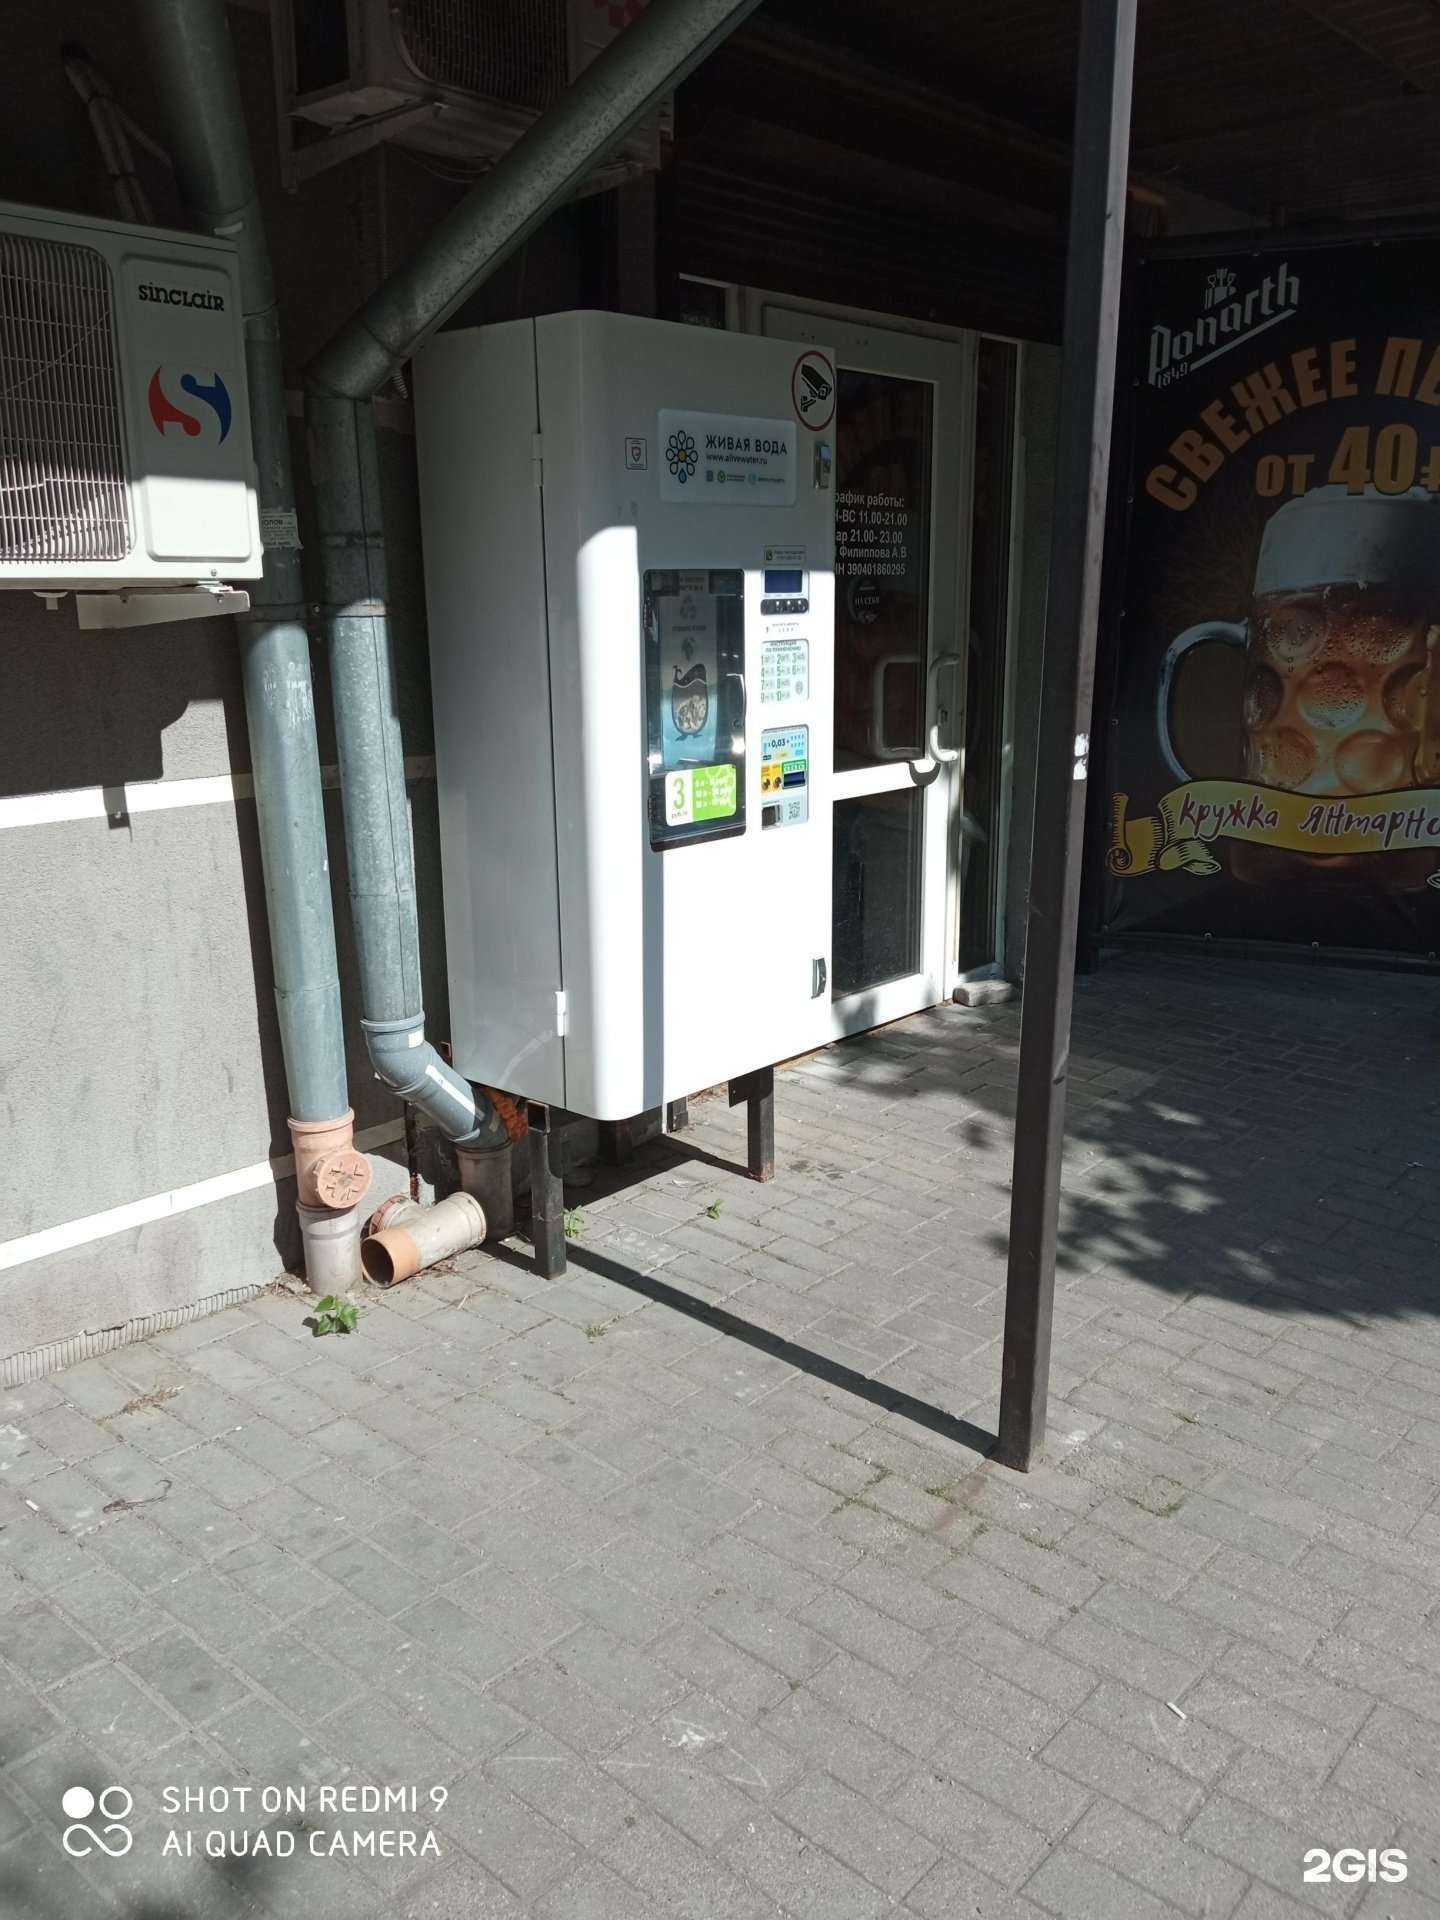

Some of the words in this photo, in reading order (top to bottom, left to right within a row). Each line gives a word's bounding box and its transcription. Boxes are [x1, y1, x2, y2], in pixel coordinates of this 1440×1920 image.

[1144, 337, 1360, 512] СВЕЖЕЕ
[705, 434, 751, 452] ЖИВАЯ
[755, 439, 788, 456] ВОДА
[1256, 453, 1316, 498] ОТ
[834, 489, 865, 508] рафик
[867, 492, 905, 509] работы:
[858, 509, 908, 526] 11.00-21.00
[835, 530, 848, 544] ар
[839, 544, 891, 559] Филиппова
[673, 777, 685, 810] 3
